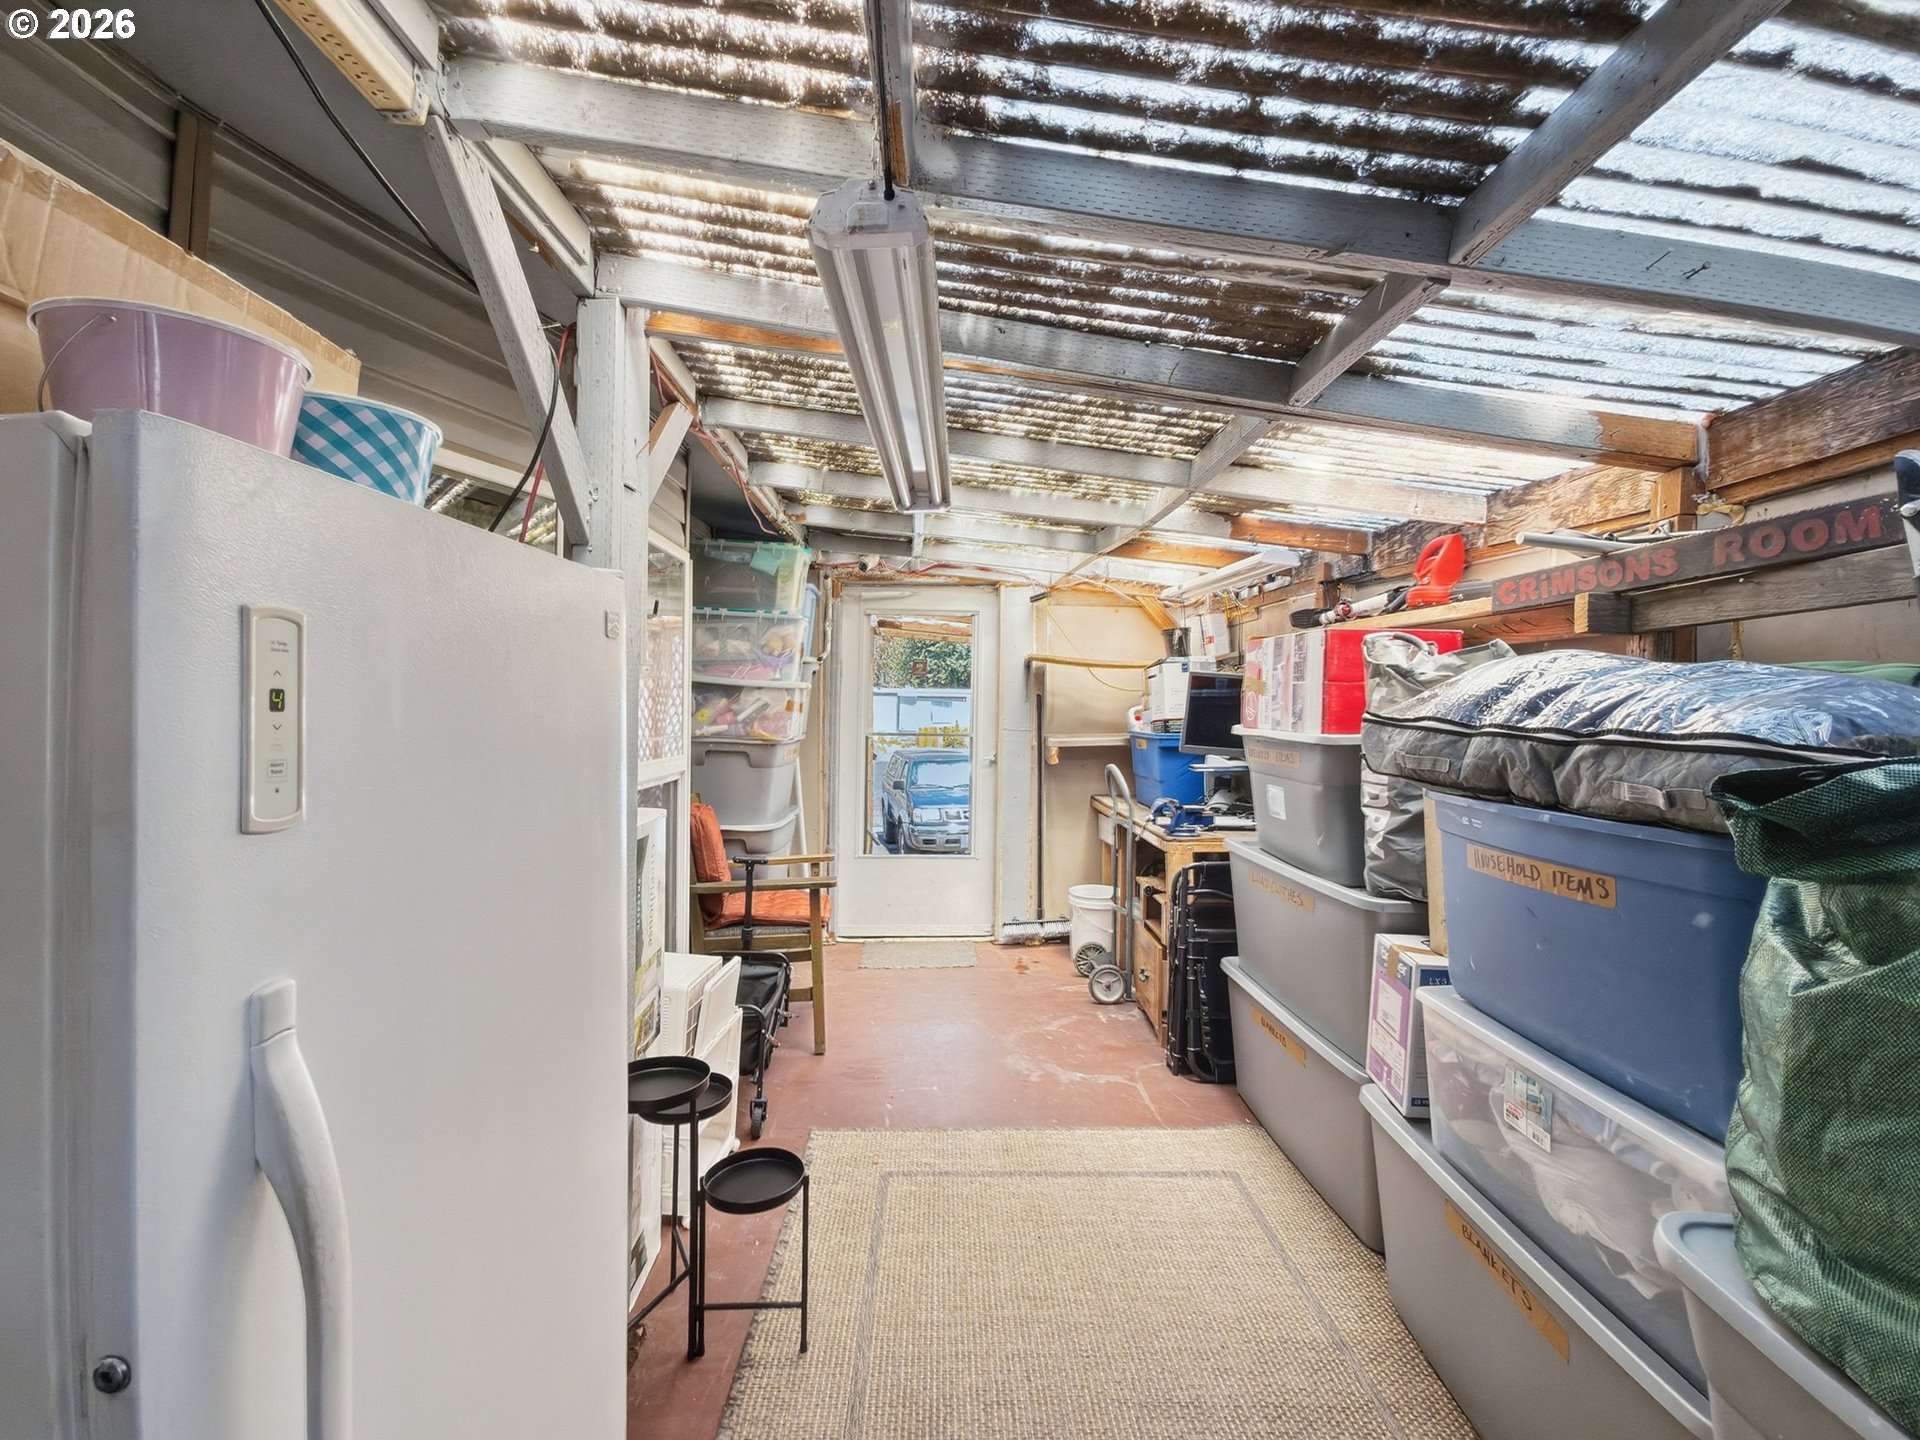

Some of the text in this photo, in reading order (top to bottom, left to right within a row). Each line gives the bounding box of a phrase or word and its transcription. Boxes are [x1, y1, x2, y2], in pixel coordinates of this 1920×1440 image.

[1713, 505, 1882, 567] ROOM
[271, 692, 284, 710] 4
[1474, 849, 1610, 900] HOUSEHOLD ITEMS
[1462, 1224, 1532, 1312] BLANKETS
